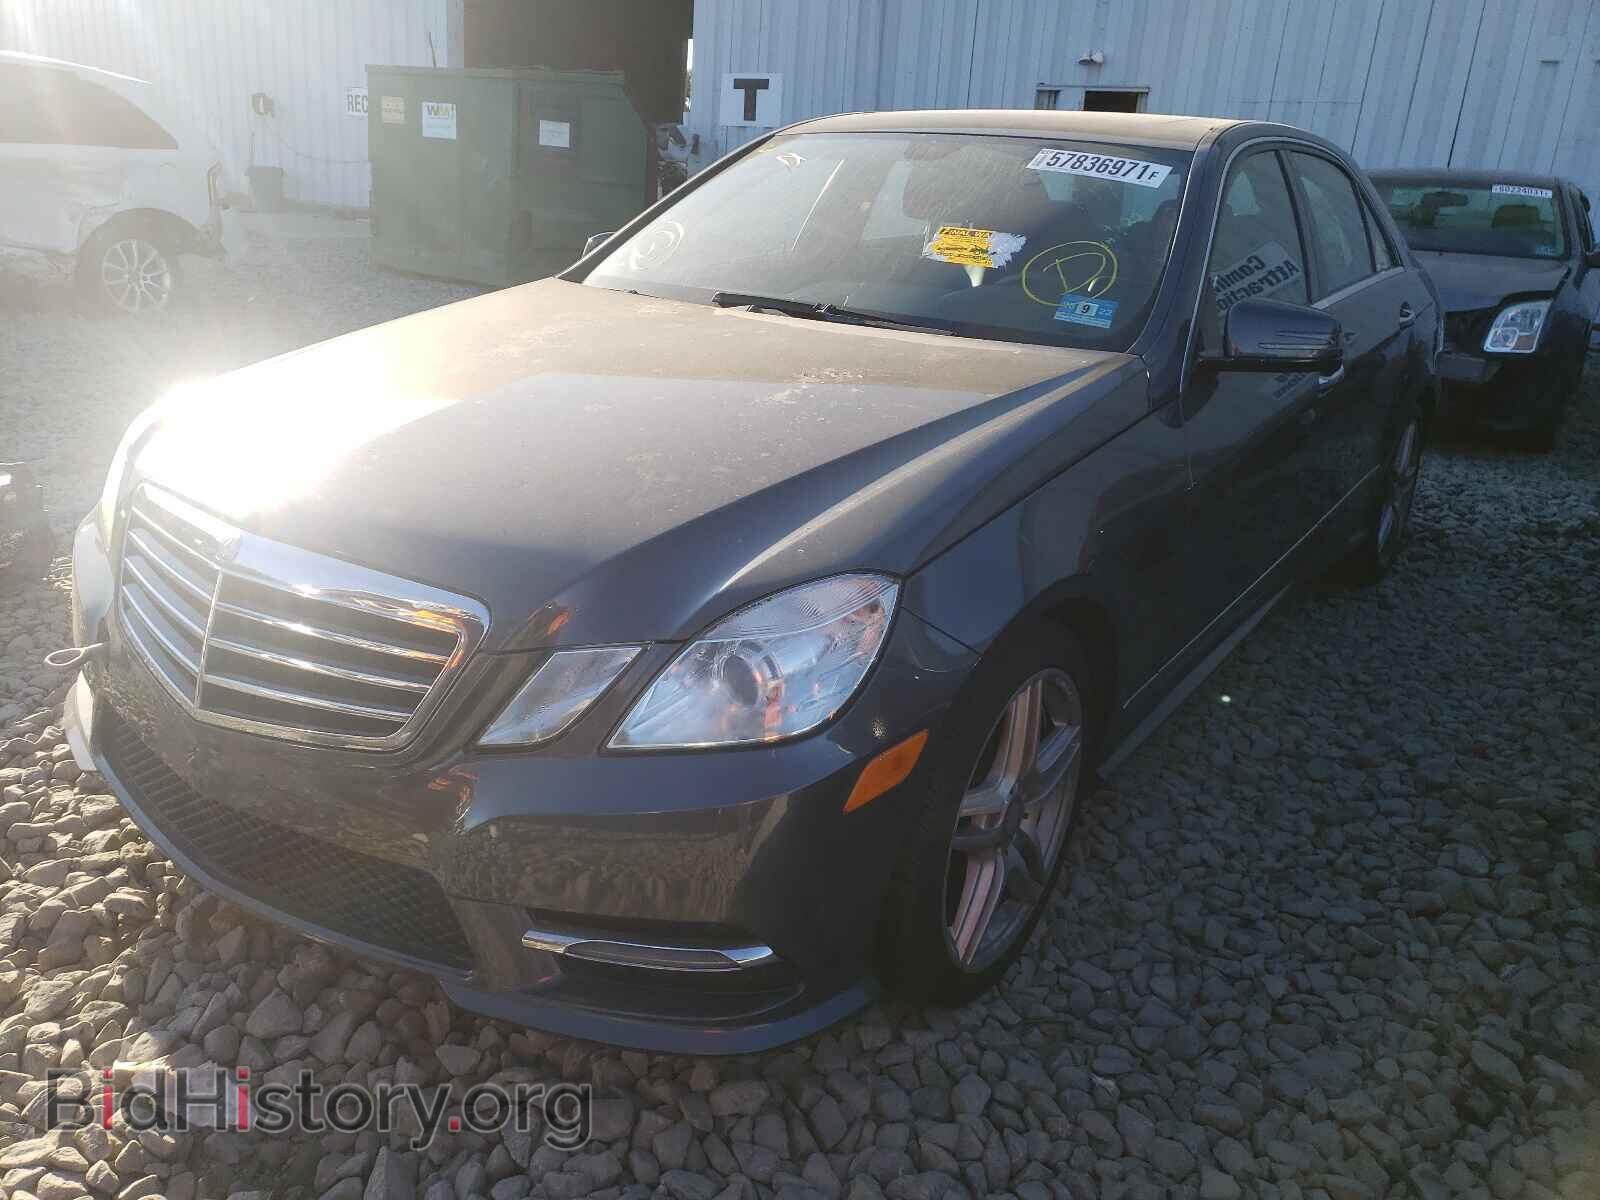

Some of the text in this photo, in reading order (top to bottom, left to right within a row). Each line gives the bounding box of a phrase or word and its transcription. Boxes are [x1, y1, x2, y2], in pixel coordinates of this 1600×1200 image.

[733, 78, 770, 121] T
[1046, 152, 1150, 180] 57836971
[1148, 171, 1160, 180] F
[1081, 304, 1090, 314] 9
